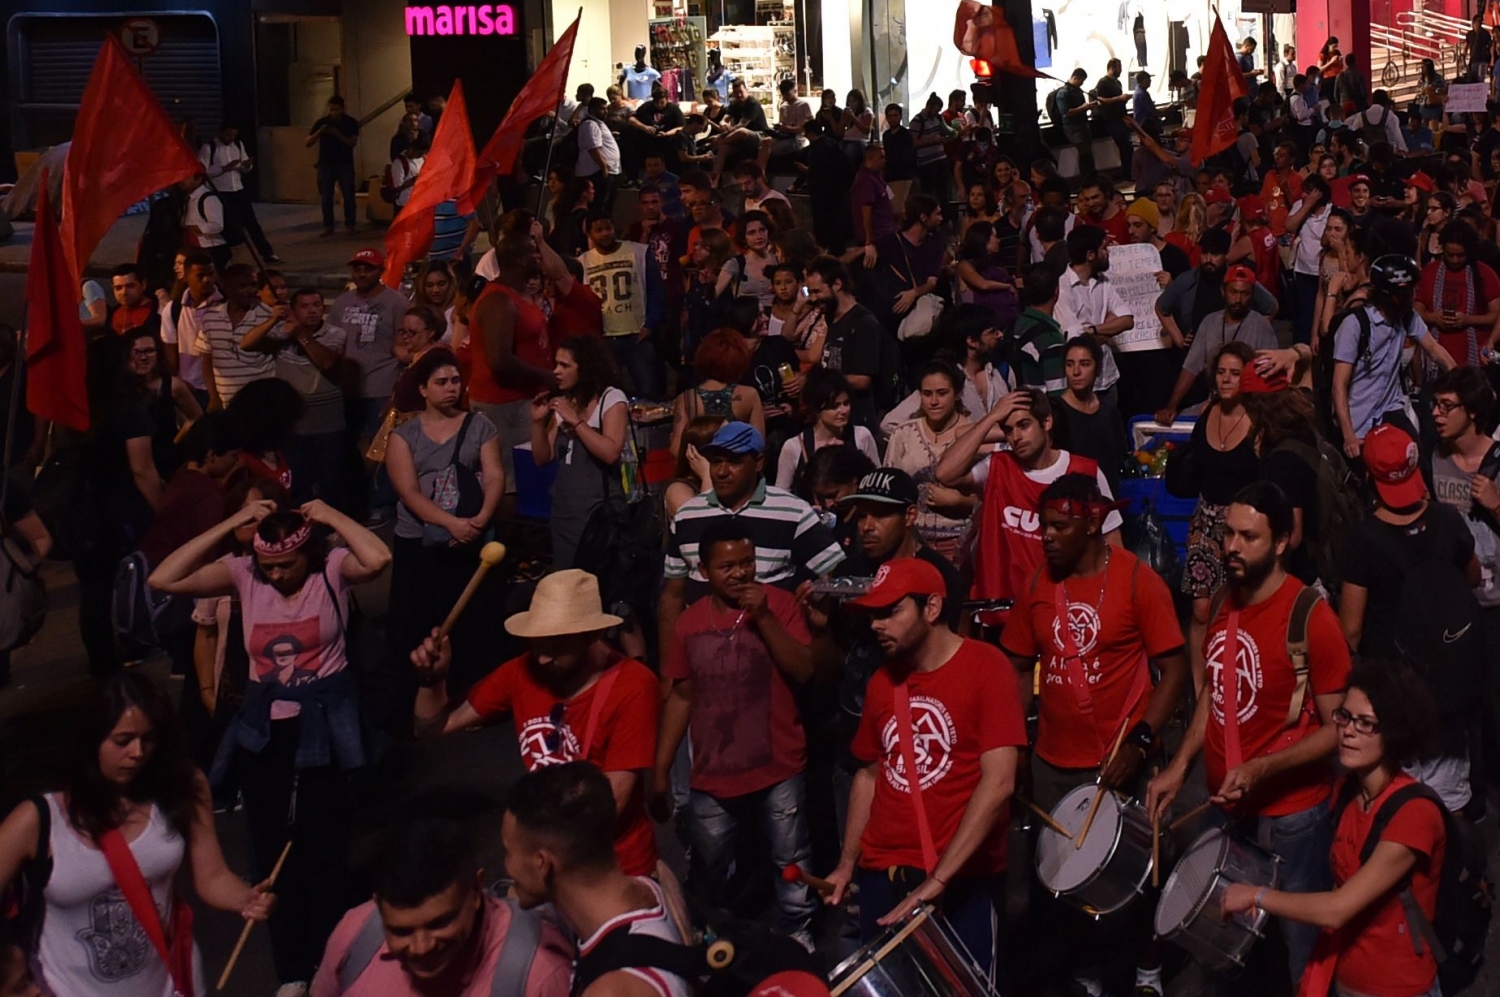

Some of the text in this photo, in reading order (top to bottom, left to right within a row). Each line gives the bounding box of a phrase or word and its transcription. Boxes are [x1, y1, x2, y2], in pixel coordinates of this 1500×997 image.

[404, 4, 514, 36] marisa
[602, 303, 633, 315] ACH
[1437, 480, 1471, 501] CLASS
[1003, 505, 1040, 533] CU
[1049, 655, 1057, 669] A
[1092, 656, 1100, 670] é
[909, 695, 958, 745] ABALHADORES SEM TETO
[896, 763, 931, 775] BSIL
